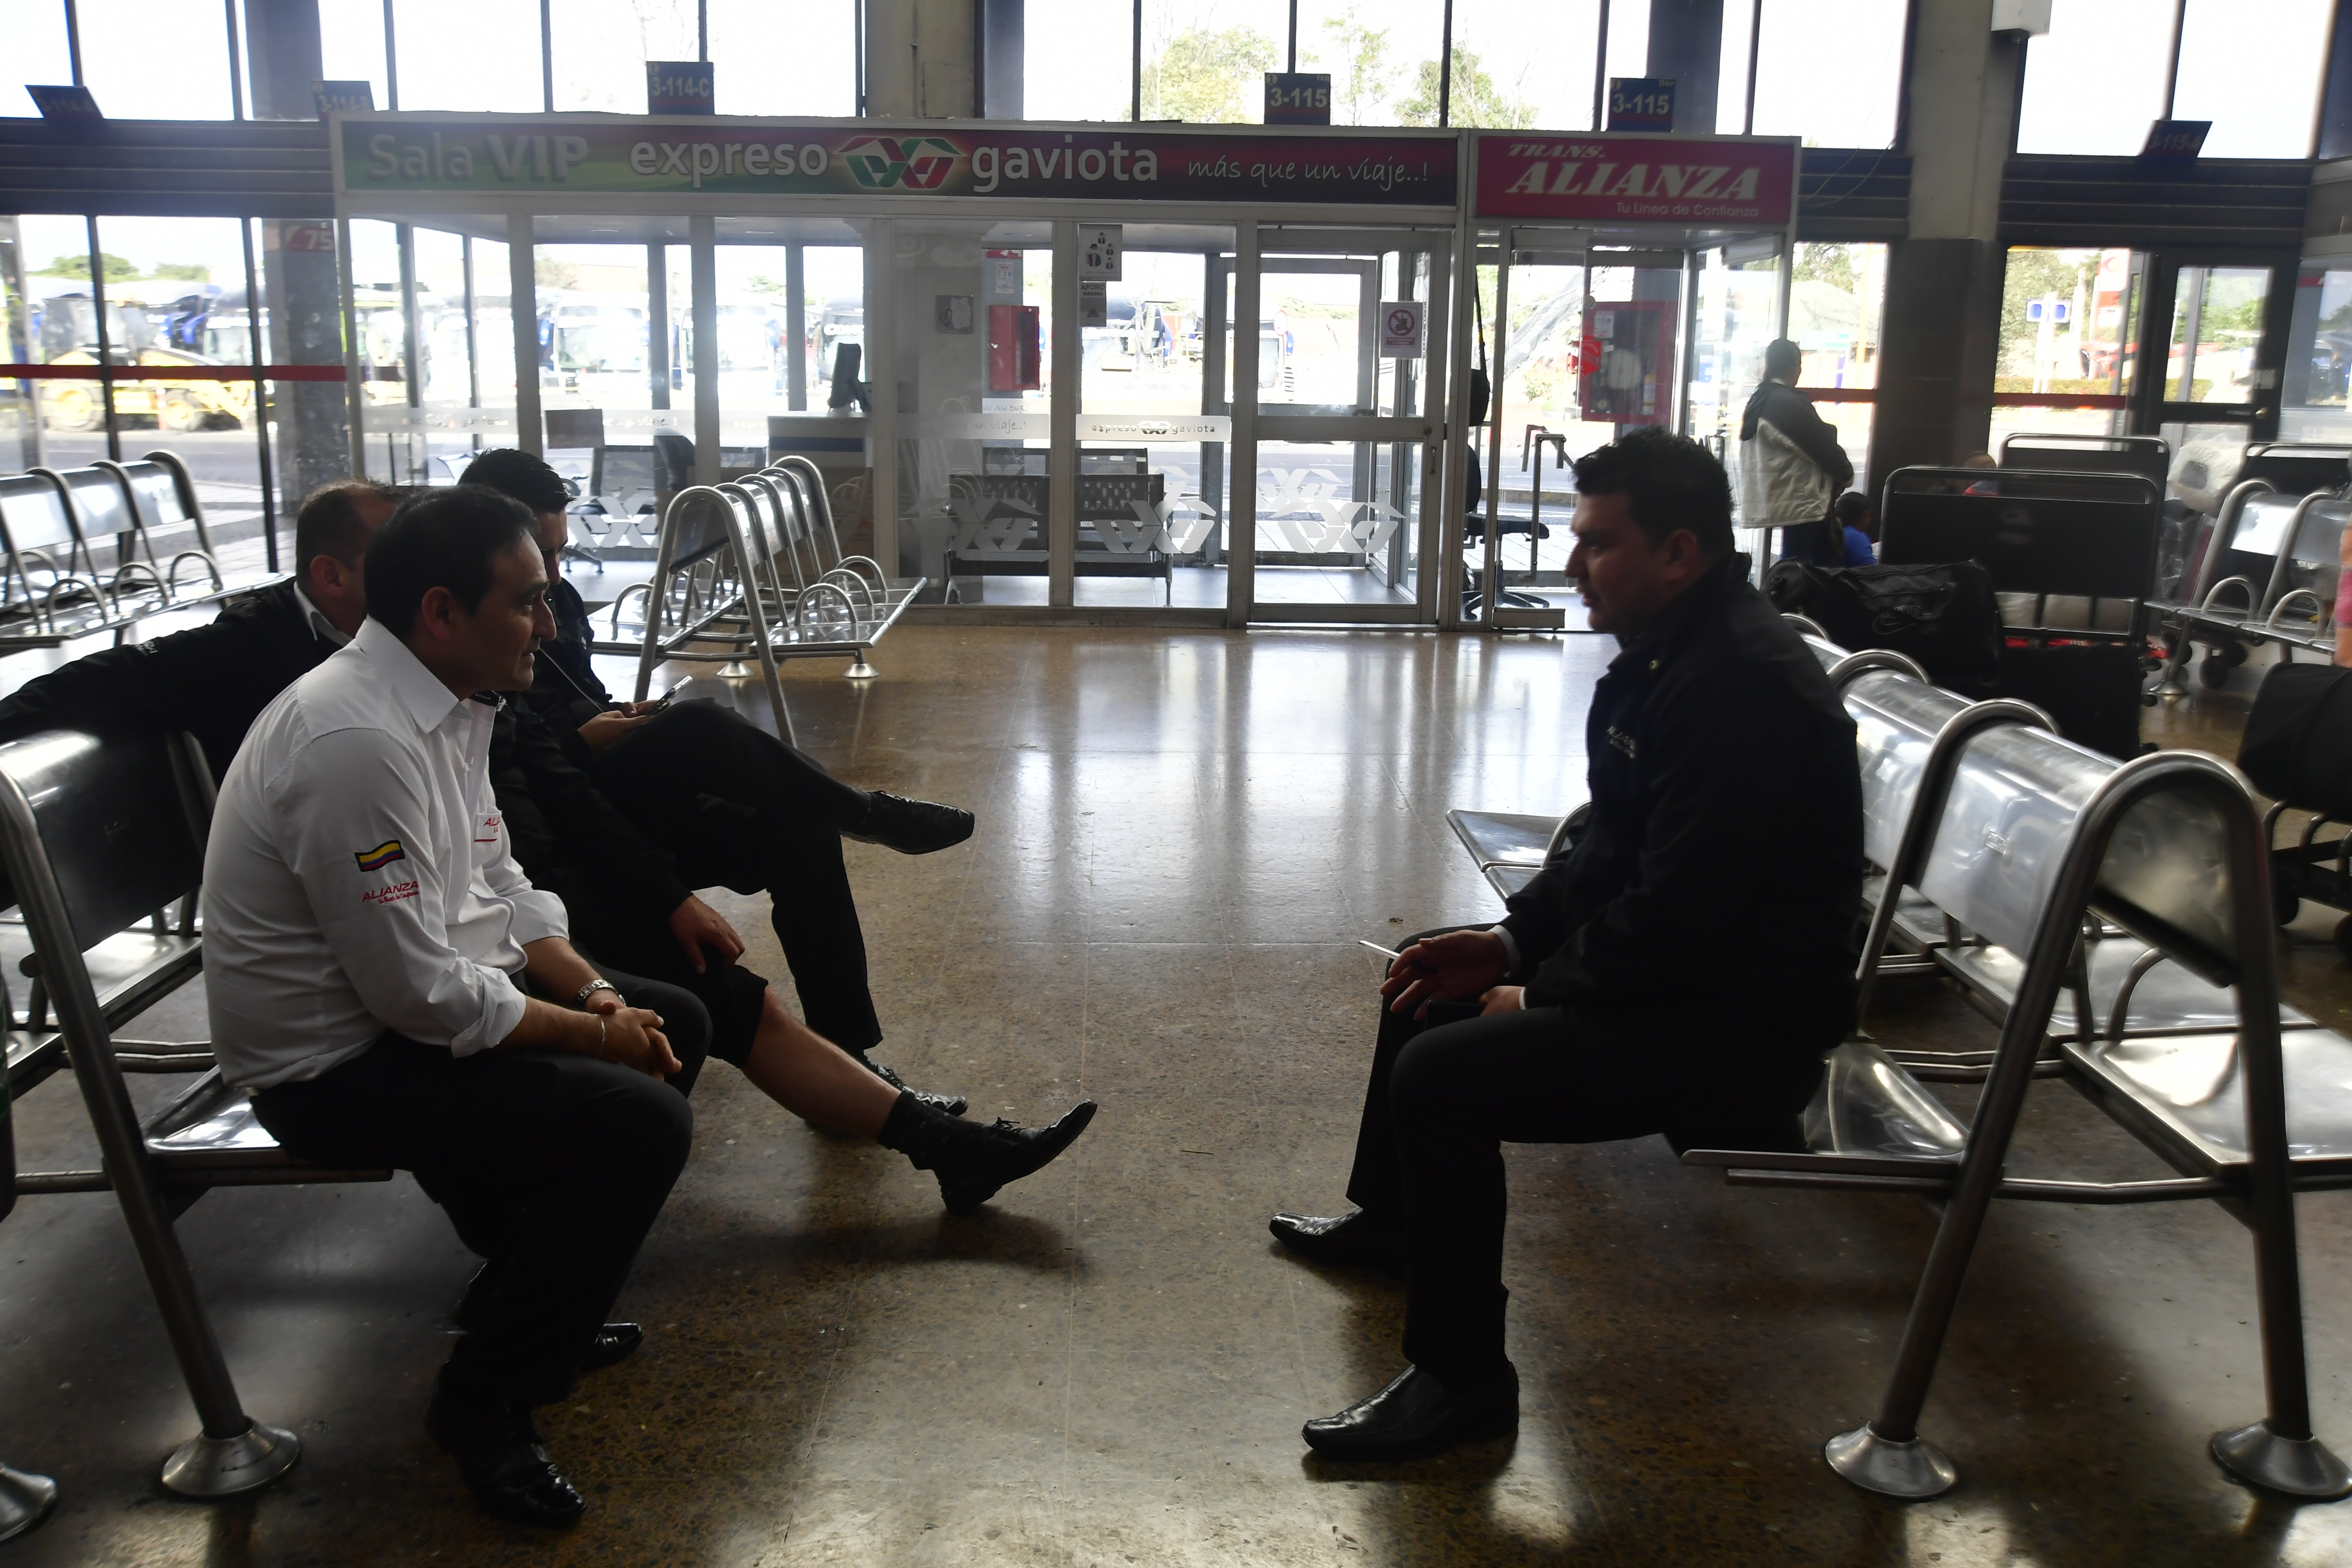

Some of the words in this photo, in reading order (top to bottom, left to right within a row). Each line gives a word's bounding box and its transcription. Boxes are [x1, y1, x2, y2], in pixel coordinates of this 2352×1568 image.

[652, 76, 709, 98] 3-114-C
[1270, 87, 1327, 108] 3-115
[1612, 93, 1669, 115] 3-115
[367, 131, 473, 180] Sala
[484, 135, 588, 181] VIP
[1507, 144, 1605, 158] TRANS.
[630, 142, 828, 188] expreso
[972, 134, 1158, 193] gaviota
[1188, 155, 1241, 178] más
[1250, 162, 1296, 187] que
[1305, 163, 1341, 180] un
[1505, 162, 1760, 200] ALIANZA
[1616, 202, 1629, 214] Tu
[1672, 204, 1689, 215] de
[1693, 205, 1758, 217] Confianza
[304, 230, 334, 250] 75
[734, 421, 767, 430] expre
[1092, 424, 1137, 433] expreso
[1172, 424, 1215, 435] gaviota
[362, 881, 419, 902] ALIANZA
